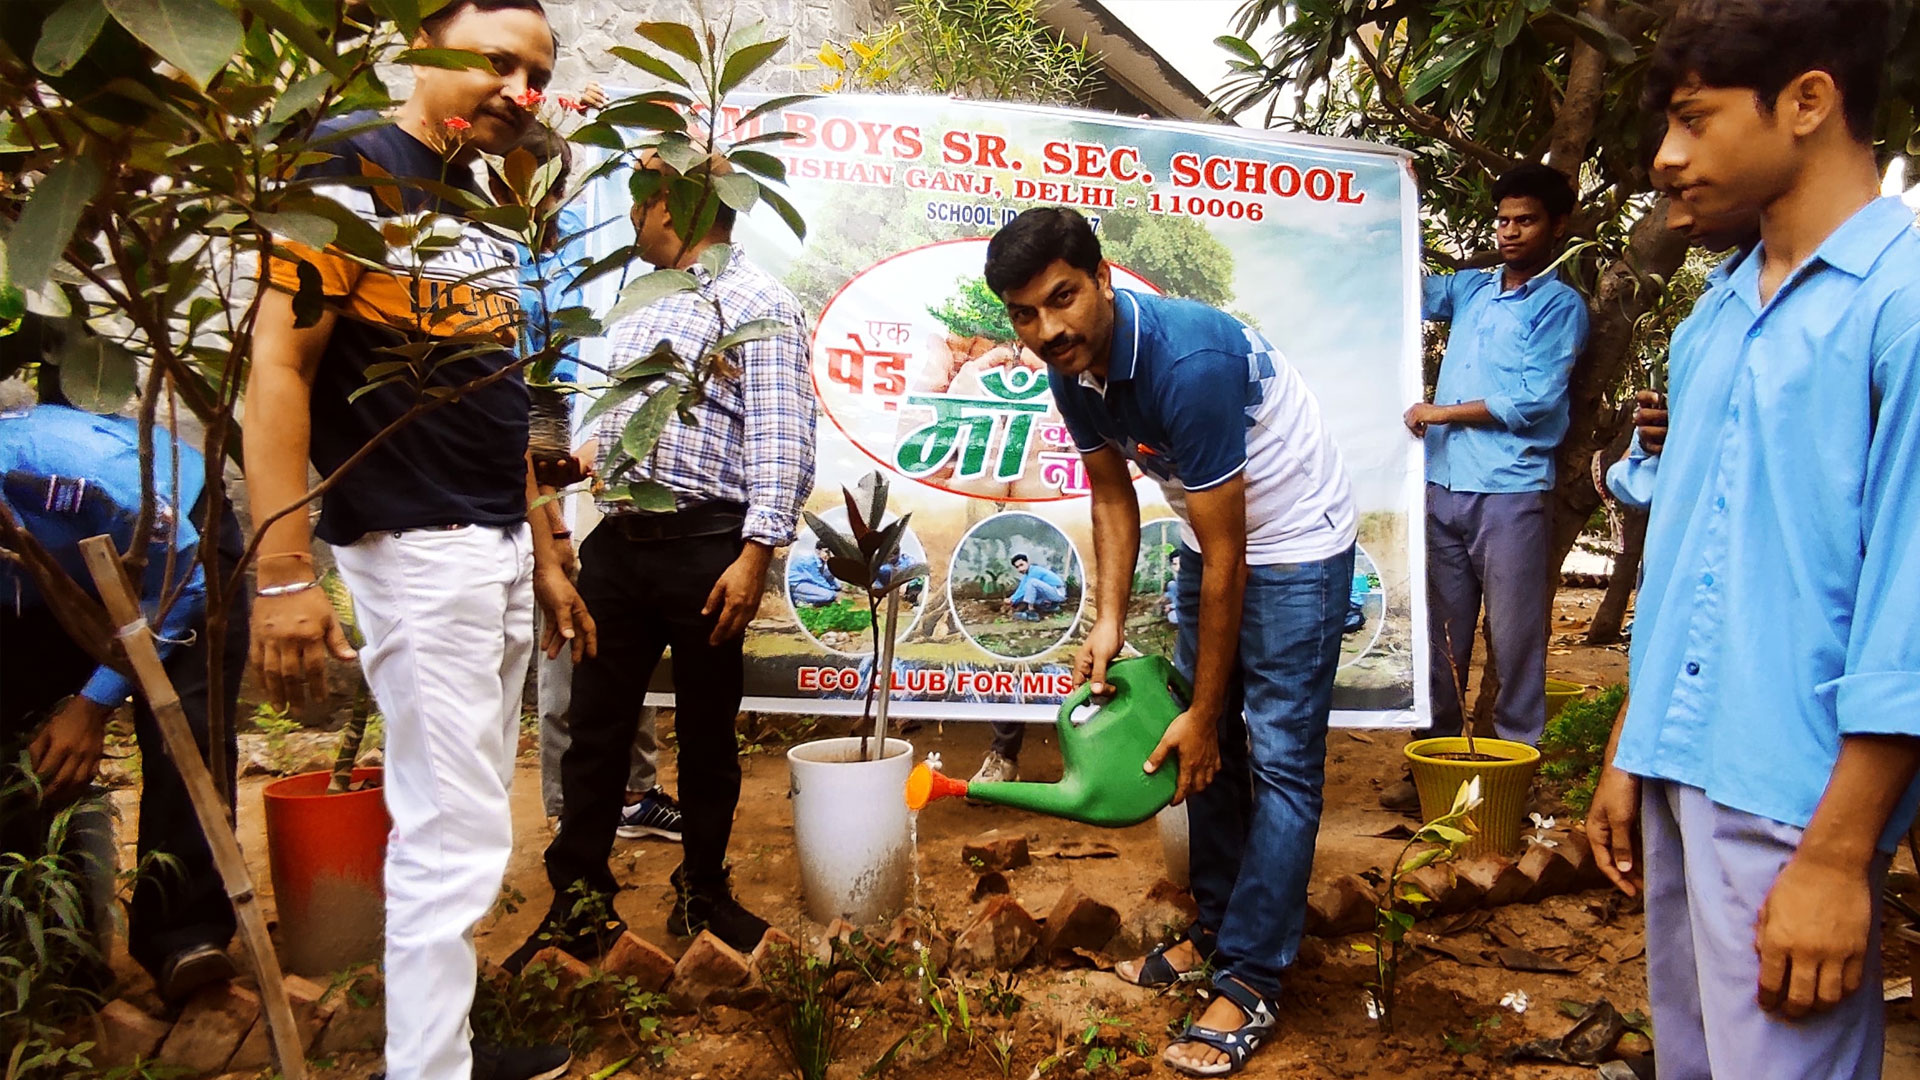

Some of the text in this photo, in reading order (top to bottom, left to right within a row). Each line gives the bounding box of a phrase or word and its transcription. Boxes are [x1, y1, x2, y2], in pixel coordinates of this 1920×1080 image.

[783, 113, 923, 159] BOYS
[943, 131, 1022, 170] SR.
[1043, 142, 1152, 183] SEC.
[1172, 154, 1366, 204] SCHOOL
[777, 156, 894, 185] ISHAN
[906, 169, 1002, 198] GANJ,
[1014, 179, 1114, 207] DELHI
[1151, 194, 1264, 221] 110006
[927, 202, 996, 226] SCHOOL
[865, 320, 912, 347] एक
[825, 332, 912, 411] पेड़
[898, 369, 1050, 479] माँ
[1041, 455, 1091, 490] ना
[799, 668, 859, 691] ECO
[957, 673, 1014, 693] FOR
[1023, 674, 1073, 695] MIS
